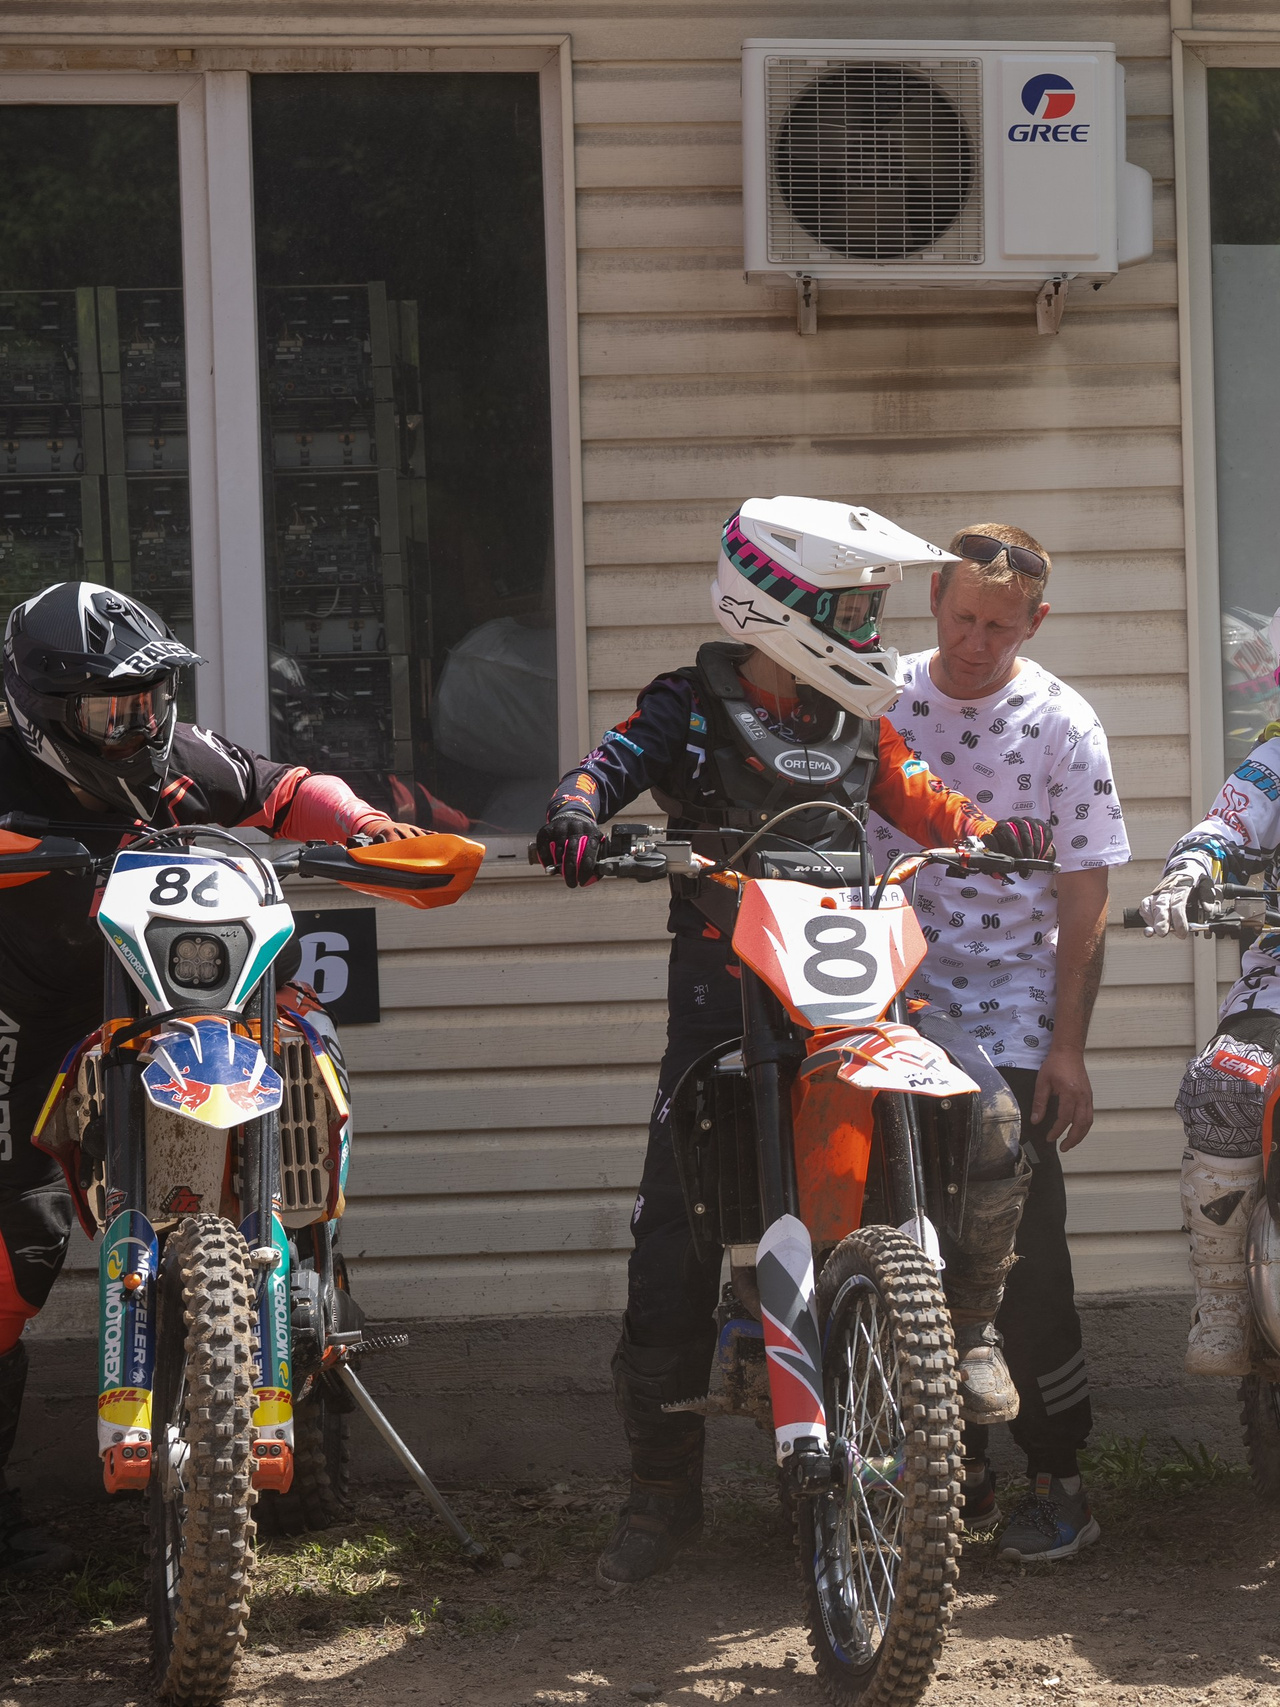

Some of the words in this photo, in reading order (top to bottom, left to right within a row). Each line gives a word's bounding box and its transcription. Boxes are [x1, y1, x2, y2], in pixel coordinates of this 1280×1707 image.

[1008, 124, 1090, 142] GREE
[912, 700, 930, 717] 96
[784, 759, 832, 771] ORTEMA
[1093, 779, 1113, 796] 96
[981, 913, 1000, 930] 96
[119, 942, 149, 979] MOTOREX
[803, 915, 878, 996] 8
[1219, 1056, 1262, 1076] LEATT
[273, 1272, 289, 1360] MOTOREX
[103, 1281, 124, 1389] MOTOREX
